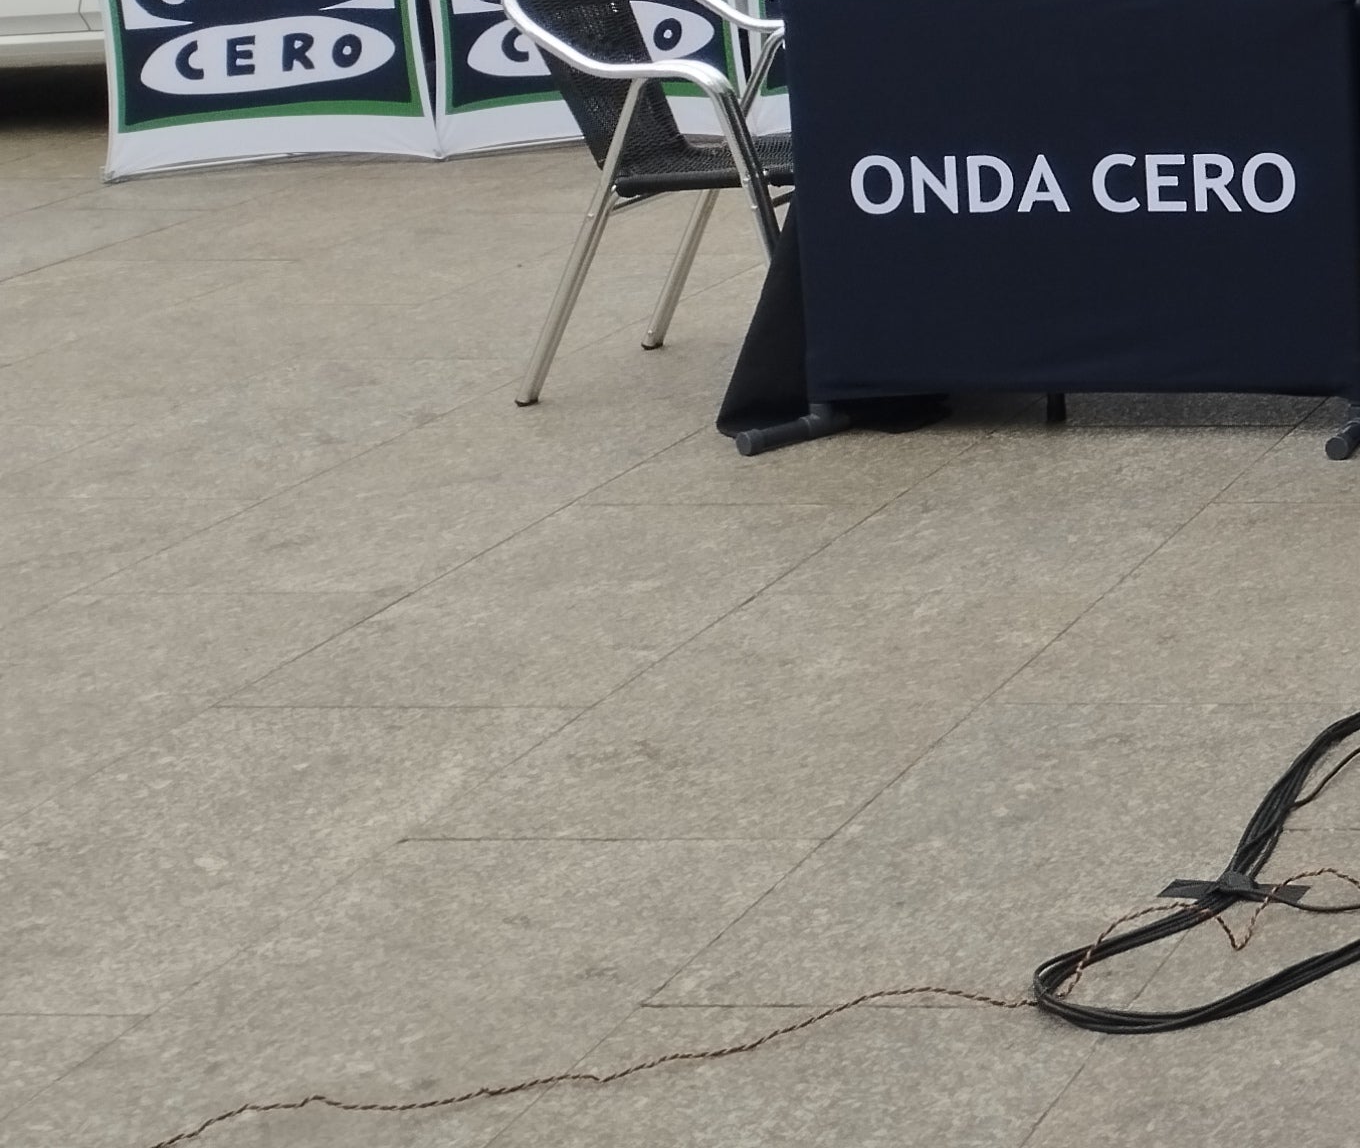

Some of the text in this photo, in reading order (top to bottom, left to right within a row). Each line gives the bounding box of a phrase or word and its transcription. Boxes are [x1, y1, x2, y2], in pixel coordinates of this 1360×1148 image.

[176, 31, 364, 82] CERO
[501, 17, 683, 63] CO
[850, 152, 1297, 216] ONDA CERO
